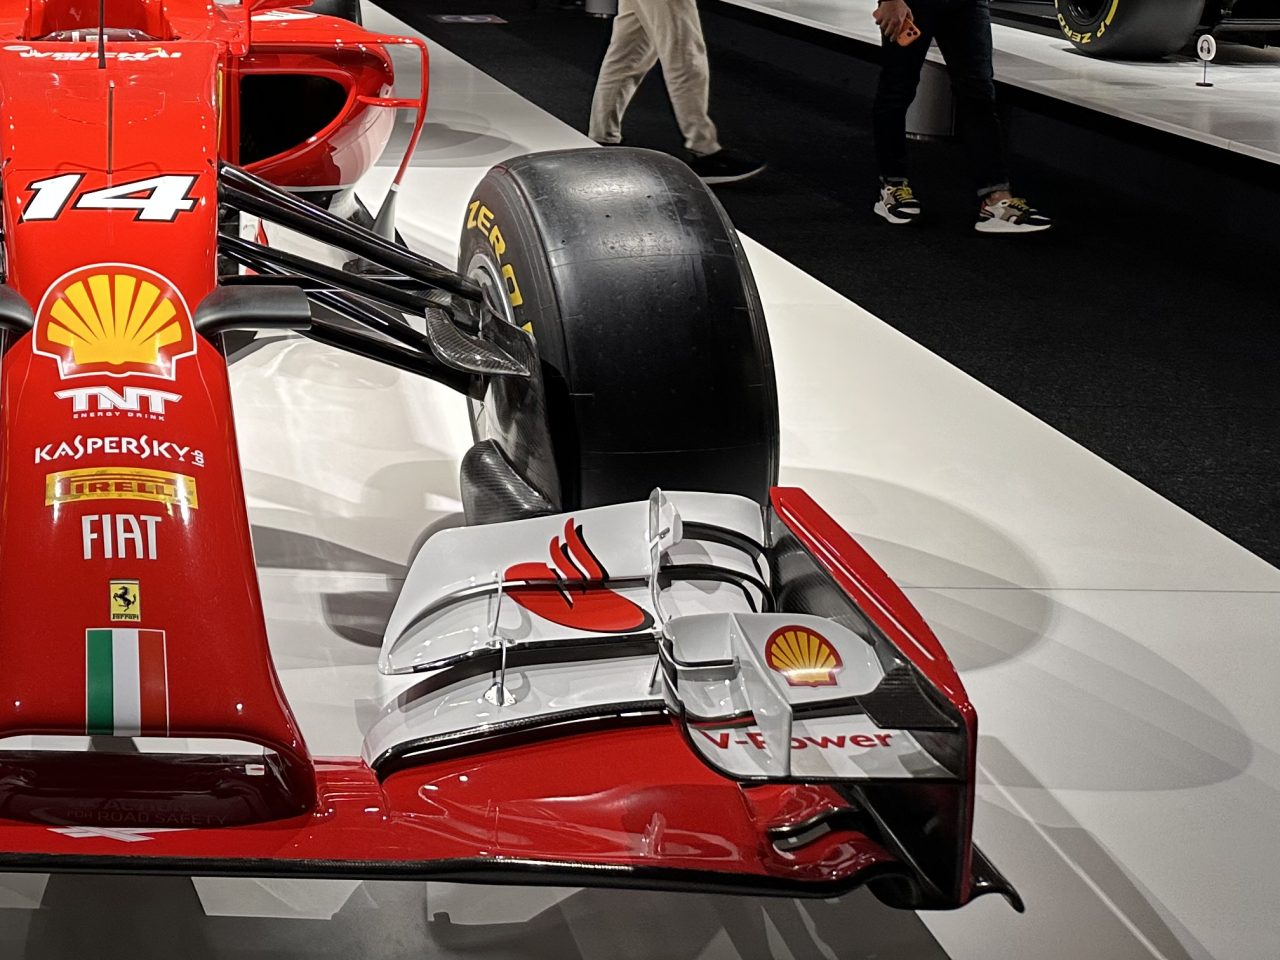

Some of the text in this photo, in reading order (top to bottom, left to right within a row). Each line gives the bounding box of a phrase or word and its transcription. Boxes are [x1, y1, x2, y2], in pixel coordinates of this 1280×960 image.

[1057, 13, 1106, 43] P ZERO
[17, 172, 200, 223] 14
[467, 200, 524, 307] ZERO
[54, 385, 183, 415] TNT
[73, 411, 165, 422] ENERGY DRINK
[34, 434, 205, 468] KASPERSKY lab
[81, 514, 163, 560] FIAT
[112, 613, 139, 621] Ferrari
[97, 810, 150, 824] ROAD
[154, 814, 228, 826] SAFETY
